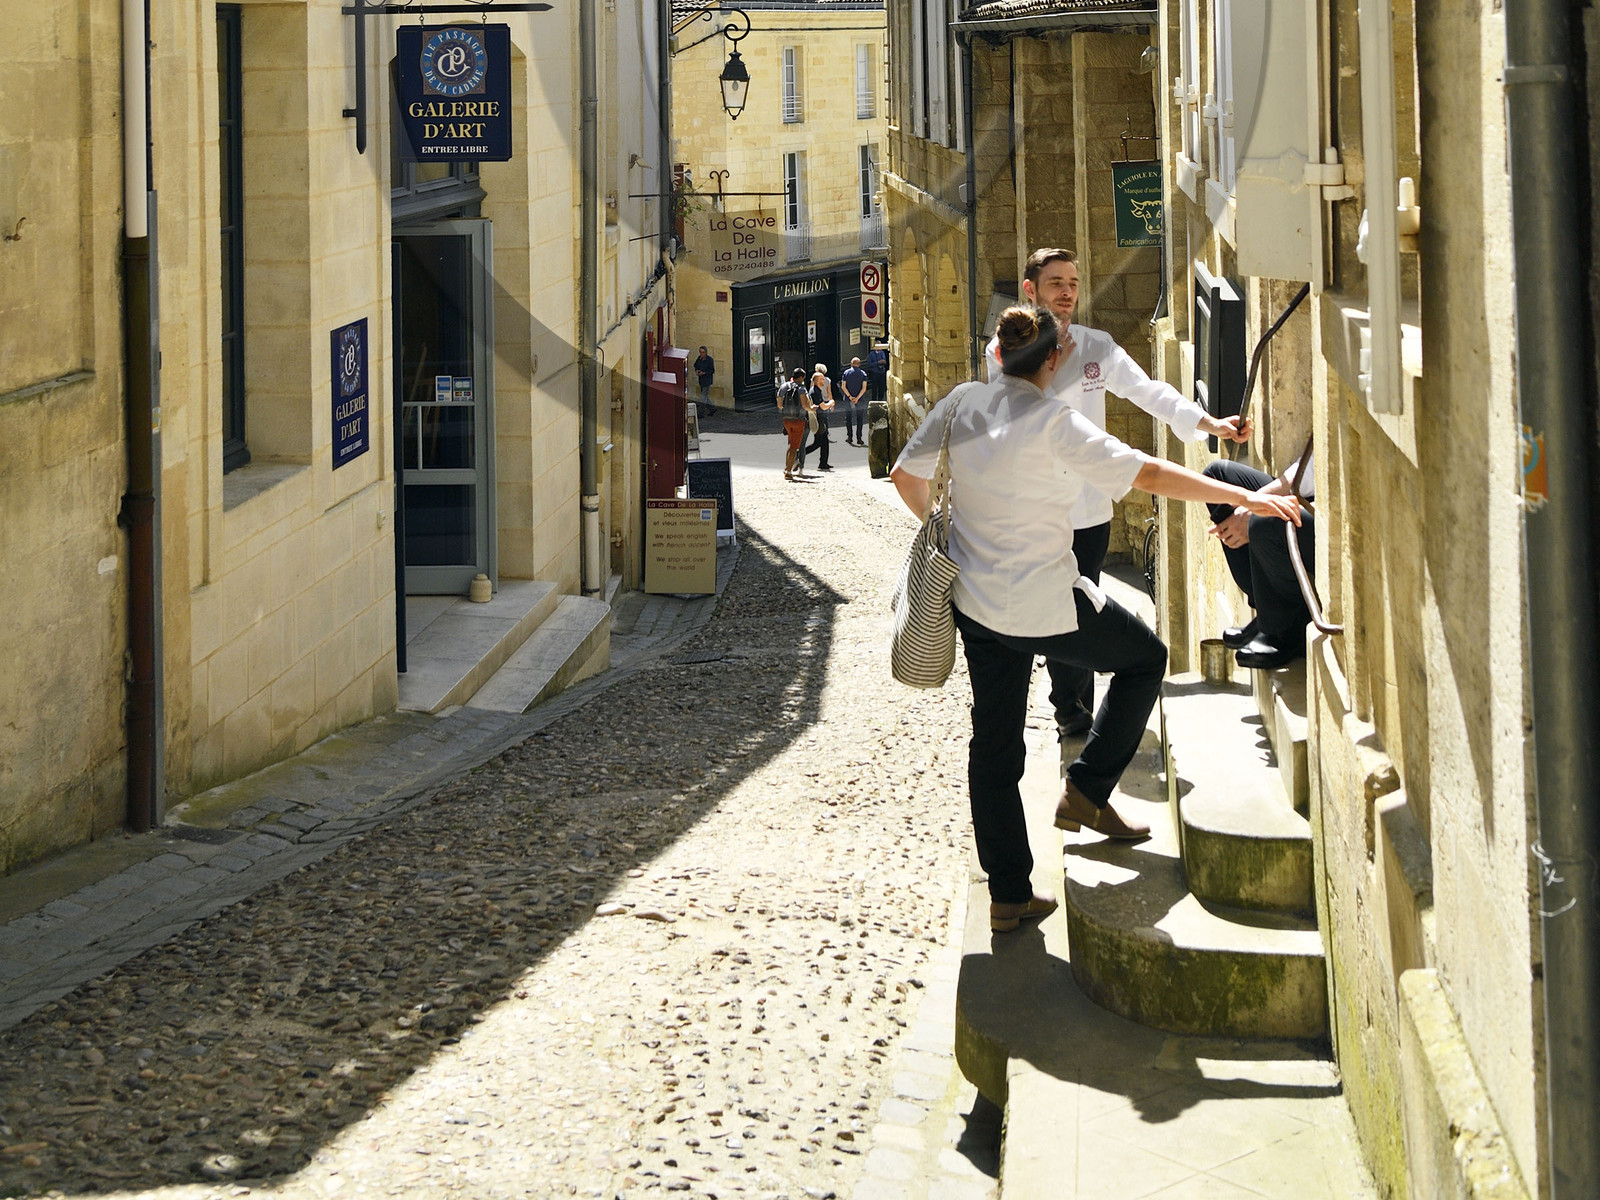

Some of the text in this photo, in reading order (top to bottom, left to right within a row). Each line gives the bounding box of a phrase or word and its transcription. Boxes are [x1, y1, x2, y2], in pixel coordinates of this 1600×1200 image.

[424, 30, 484, 58] LE PASSAGE
[425, 70, 483, 94] DE LA CADENE
[408, 101, 500, 118] GALERIE
[423, 122, 486, 139] D'ART
[710, 216, 776, 232] La Cave
[733, 232, 756, 245] De
[714, 247, 777, 262] La Halle
[714, 261, 775, 273] 0557240488
[774, 278, 830, 299] L'EMILION
[336, 394, 366, 422] GALERIE
[341, 417, 362, 441] D'ART
